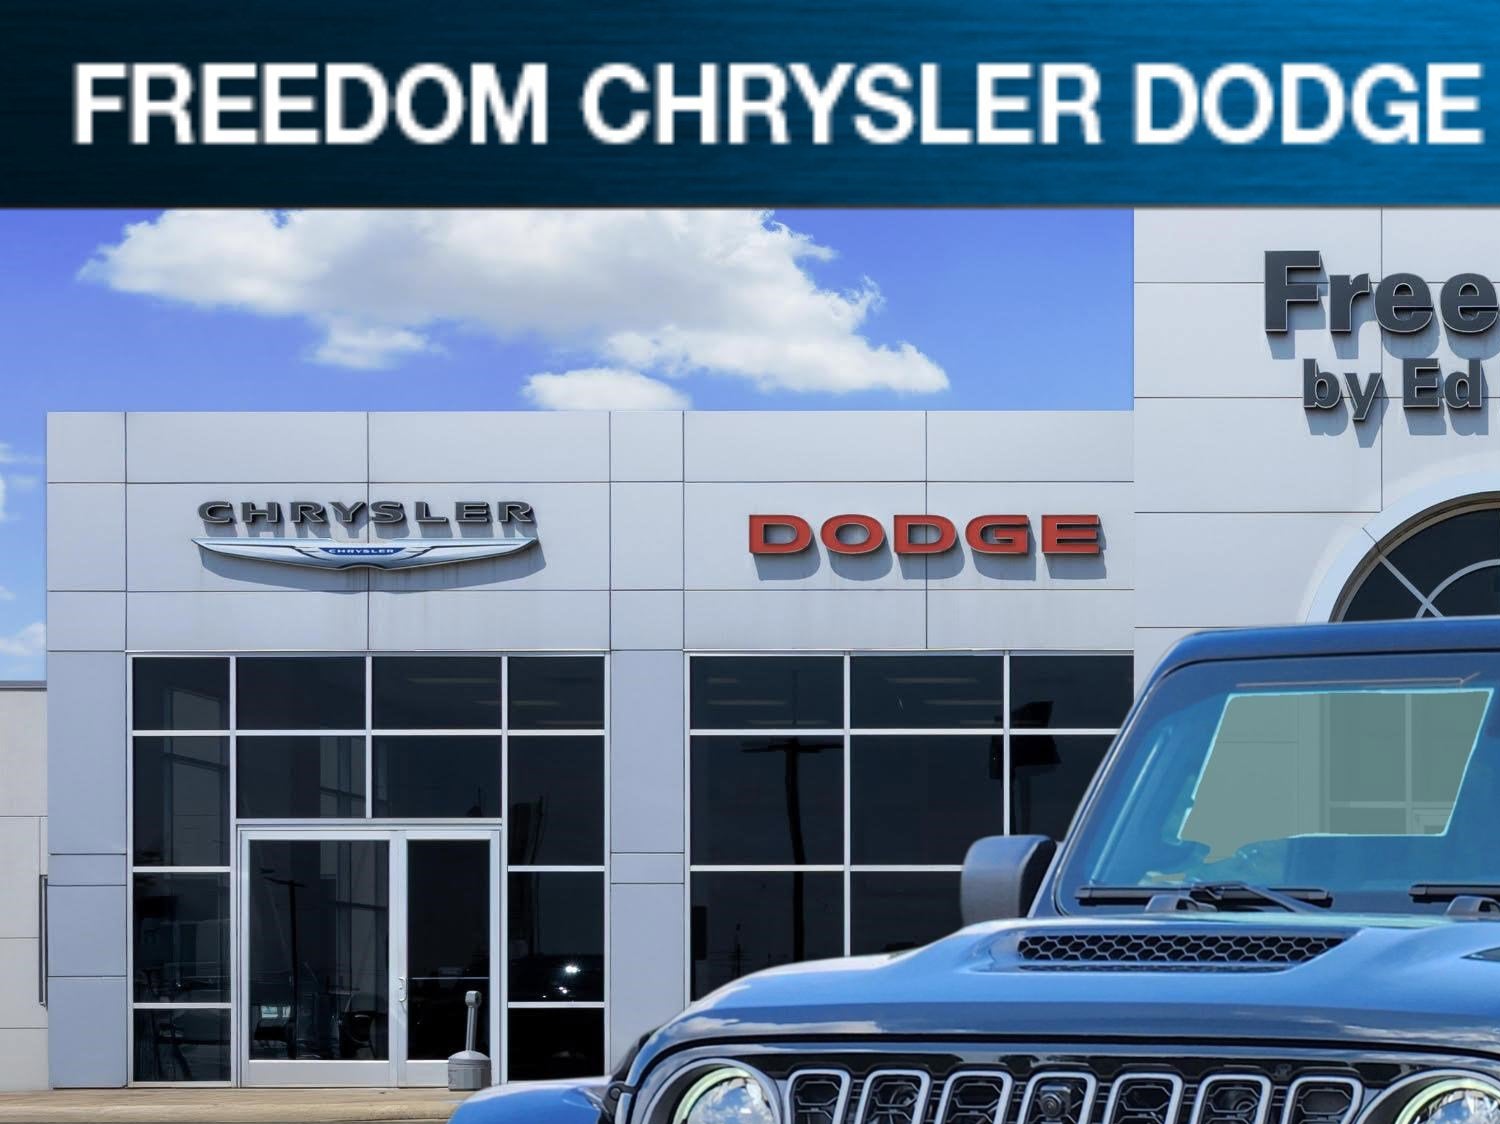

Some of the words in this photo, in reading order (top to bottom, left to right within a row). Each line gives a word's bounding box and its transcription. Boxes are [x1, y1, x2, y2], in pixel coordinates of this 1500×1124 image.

[1302, 359, 1382, 421] by
[1403, 359, 1481, 408] Ed
[198, 501, 533, 524] CHRYSLER
[749, 514, 1100, 554] DODGE
